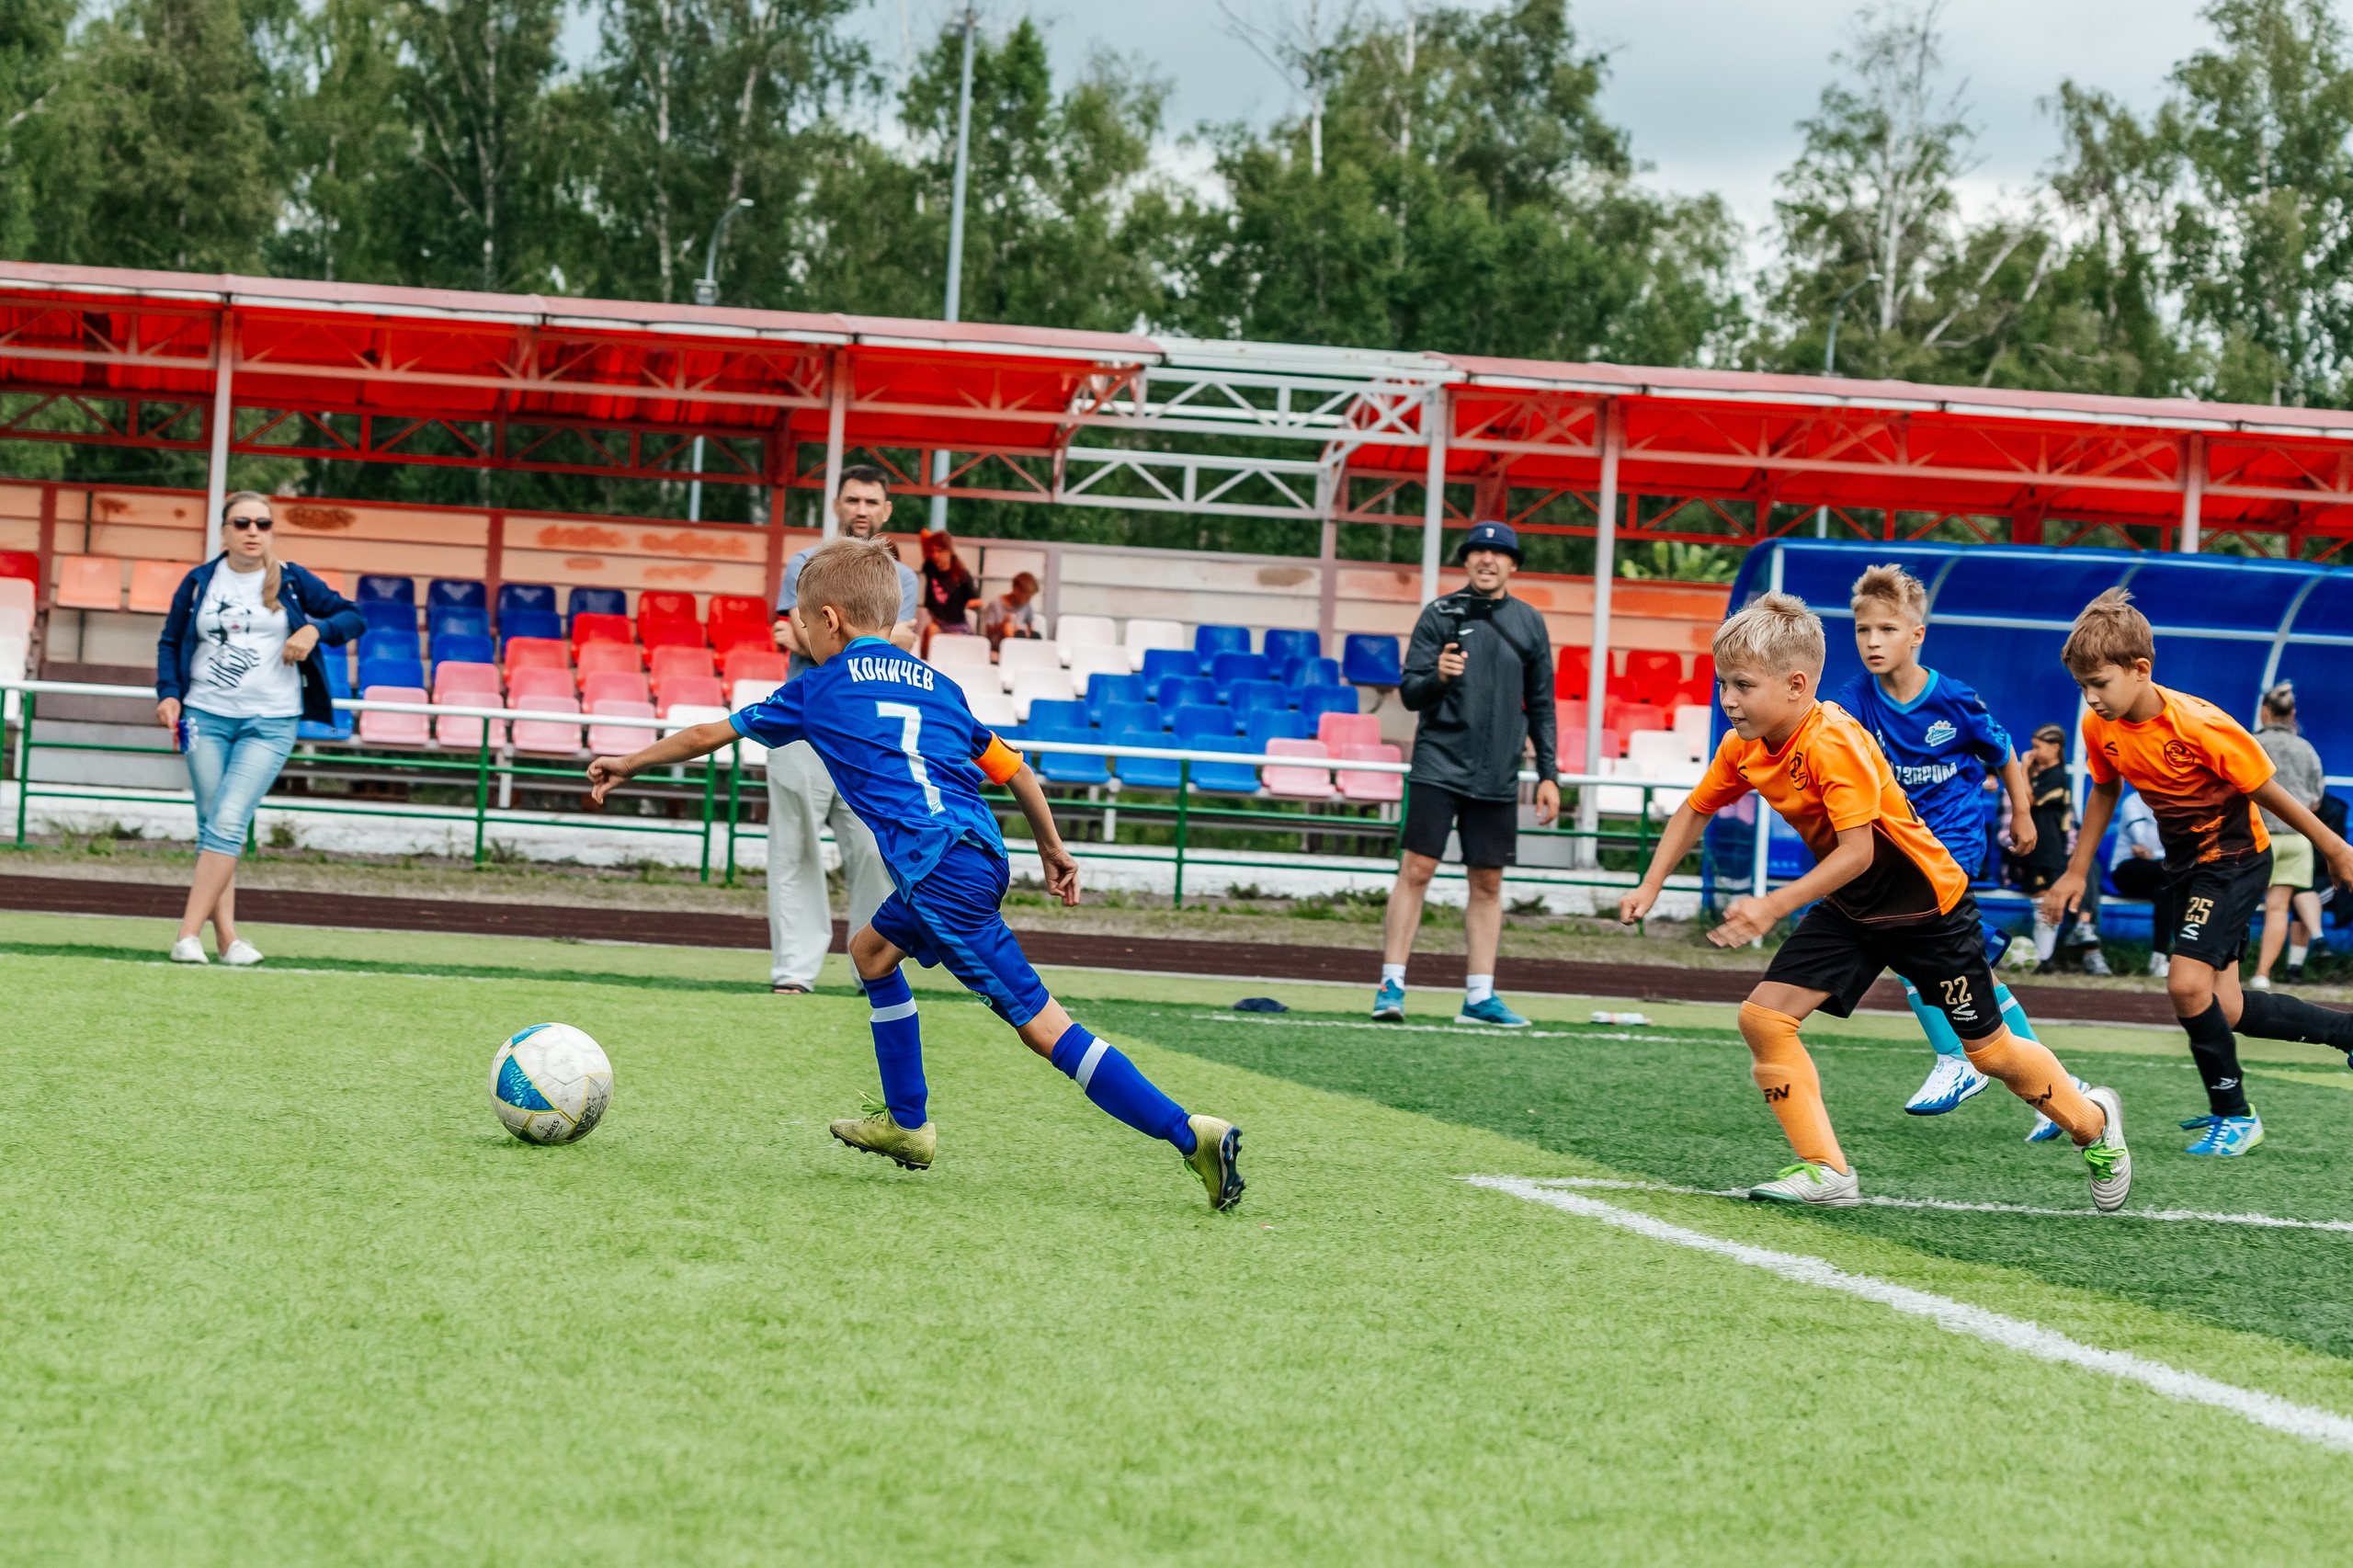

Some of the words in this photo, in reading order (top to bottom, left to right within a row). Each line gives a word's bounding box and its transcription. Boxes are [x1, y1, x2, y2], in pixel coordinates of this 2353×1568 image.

[847, 656, 935, 691] КОНИЧЕВ
[875, 700, 946, 817] 7
[2185, 896, 2214, 925] 25
[1939, 975, 1973, 1005] 22
[542, 1119, 560, 1140] TORRES
